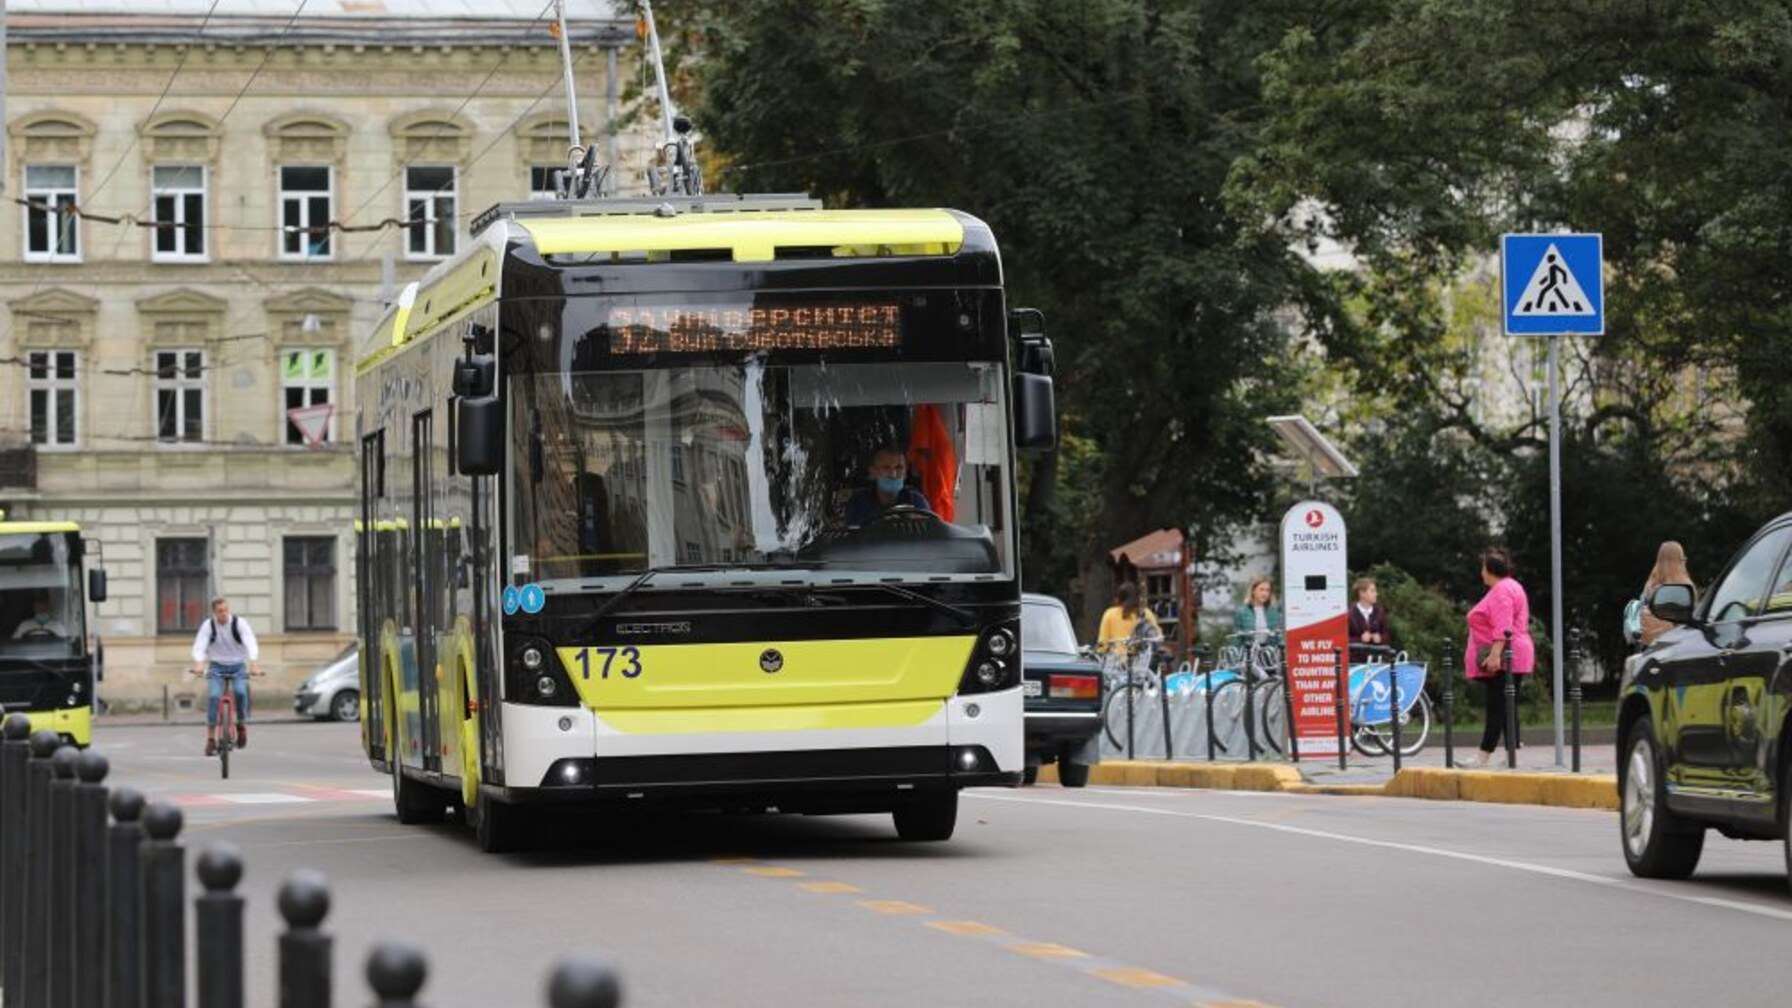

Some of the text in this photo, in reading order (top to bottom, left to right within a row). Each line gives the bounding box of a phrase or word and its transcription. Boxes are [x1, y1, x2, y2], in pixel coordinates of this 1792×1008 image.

[1292, 533, 1338, 541] TURKISH
[1292, 542, 1339, 551] AIRLINES
[1301, 640, 1333, 650] WE FLY
[575, 646, 642, 679] 173
[1298, 653, 1336, 664] TO MORE
[1295, 680, 1319, 690] THAN
[1304, 693, 1332, 703] OTHER
